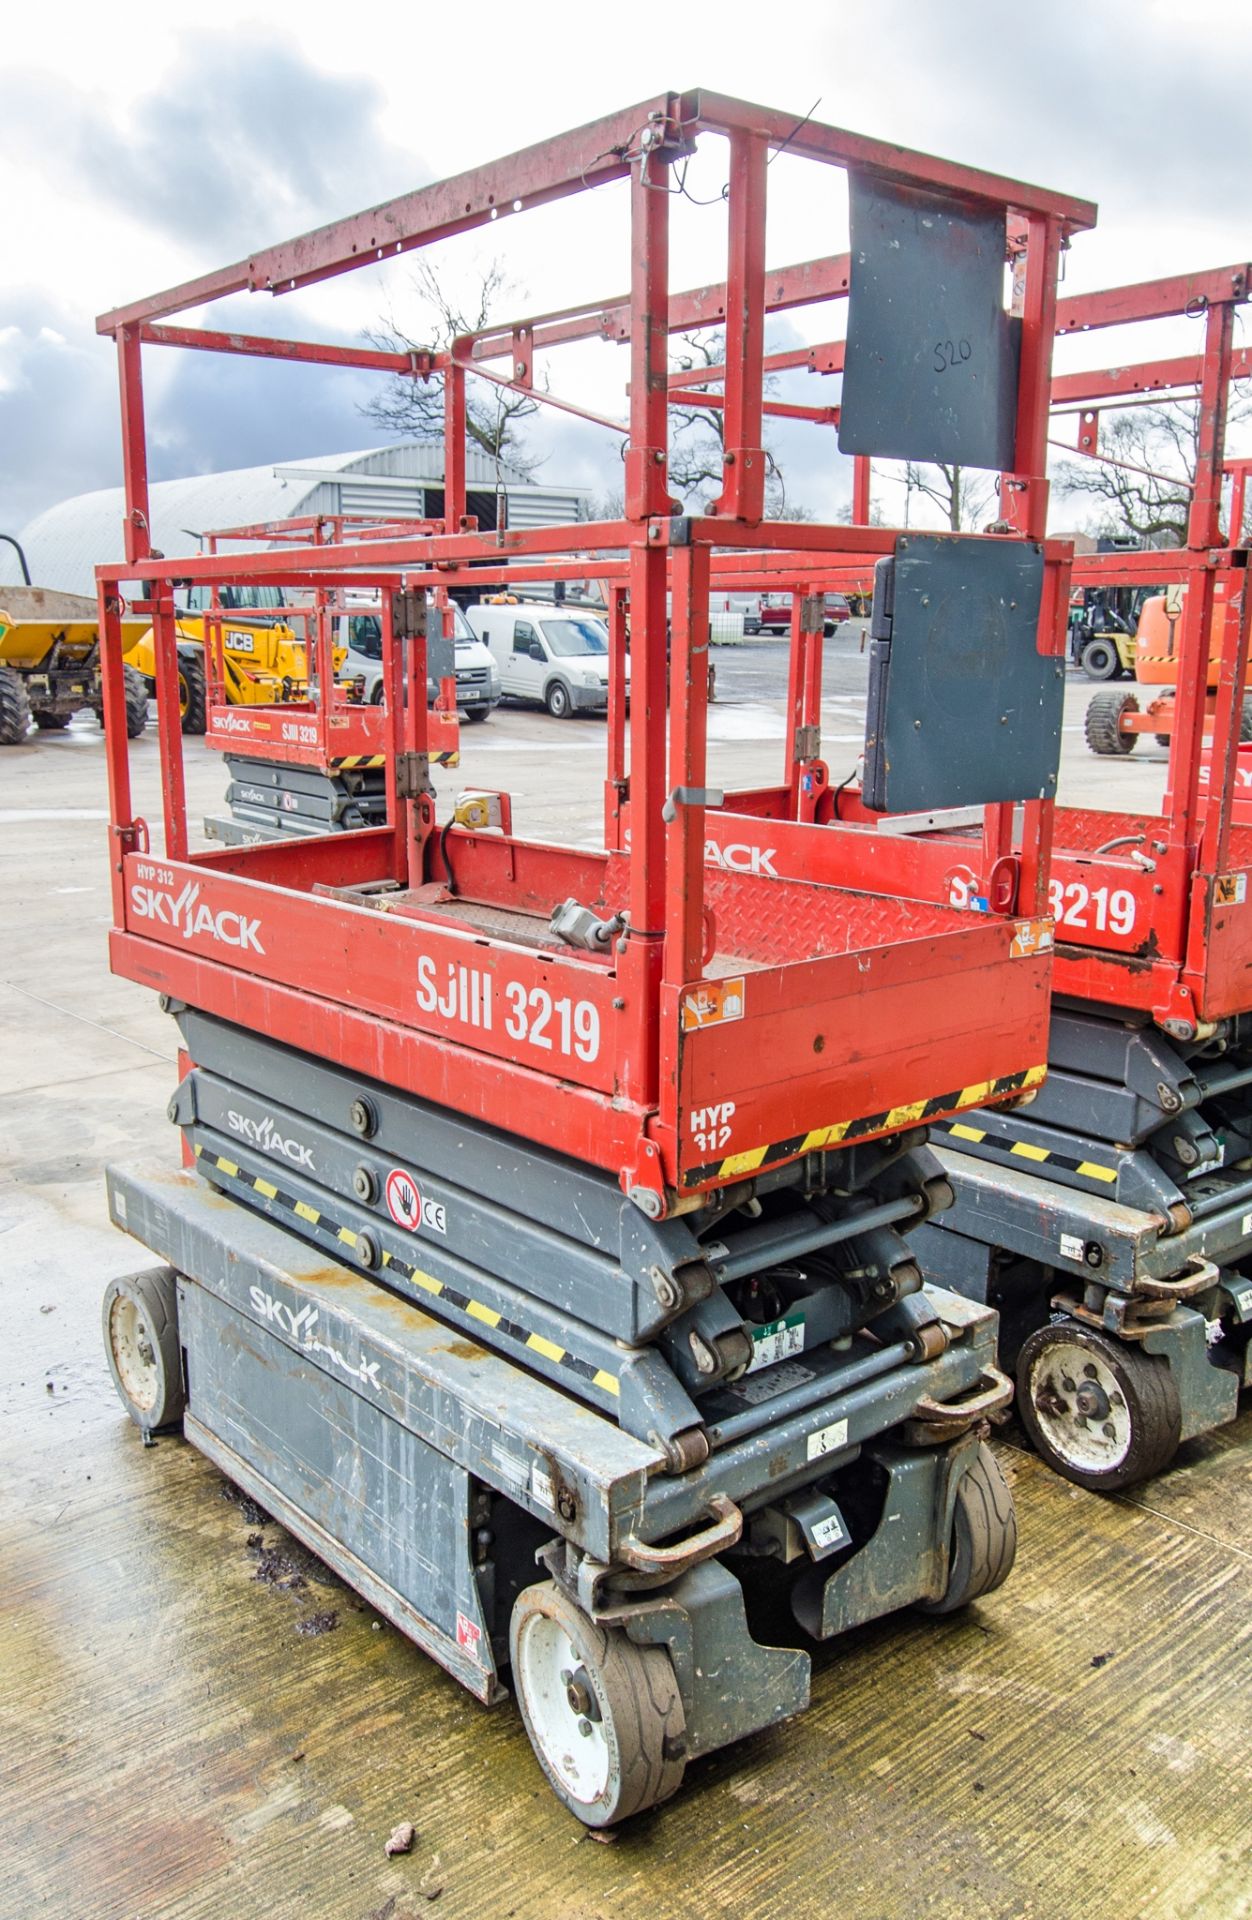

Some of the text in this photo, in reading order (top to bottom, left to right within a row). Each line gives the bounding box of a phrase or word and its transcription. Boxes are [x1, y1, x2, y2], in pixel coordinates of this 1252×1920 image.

[934, 340, 972, 373] S20
[225, 632, 254, 652] JCB
[213, 713, 251, 732] SKYJACK
[299, 726, 318, 743] 3219
[137, 864, 174, 886] HYP 312
[131, 880, 266, 955] SKYJACK
[1049, 879, 1136, 935] 3219
[505, 981, 600, 1063] 3219
[691, 1101, 736, 1132] HYP
[227, 1110, 316, 1171] SKYJACK
